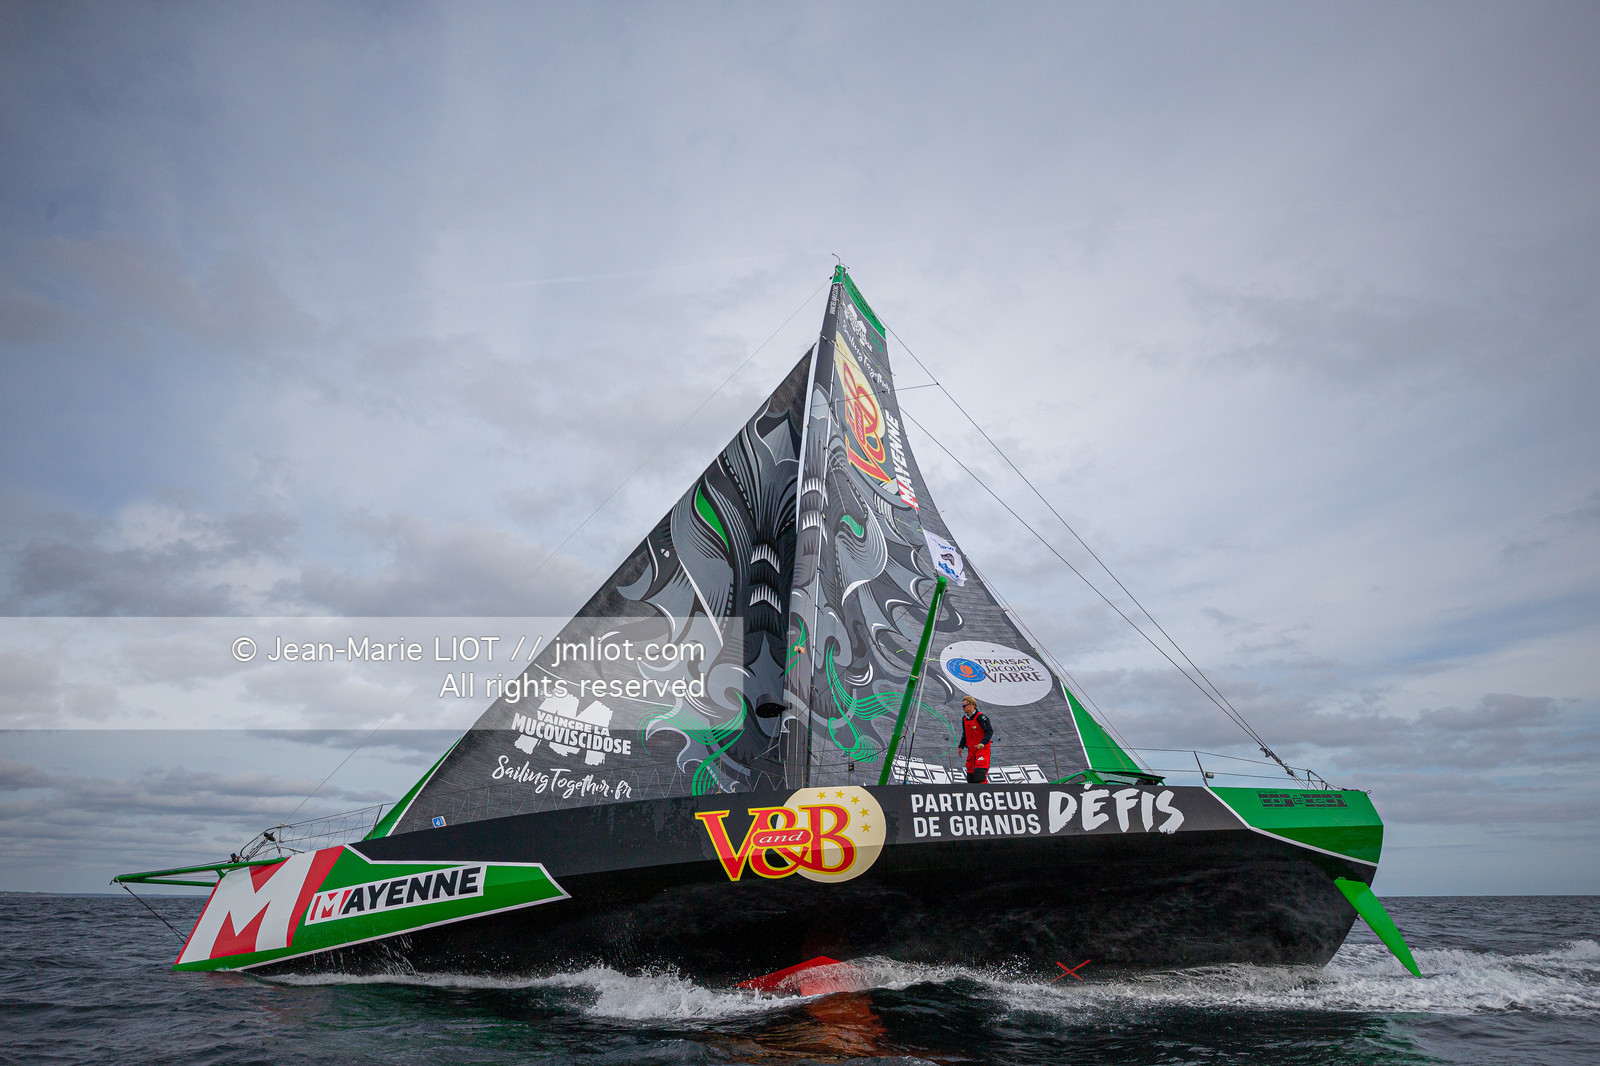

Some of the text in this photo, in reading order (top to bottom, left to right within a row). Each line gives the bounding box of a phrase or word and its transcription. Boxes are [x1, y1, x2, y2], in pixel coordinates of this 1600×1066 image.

[885, 409, 919, 511] MAYENNE
[975, 658, 1030, 666] TRANSAT
[983, 671, 1046, 683] VABRE
[511, 712, 632, 756] MUCOVISCIDOSE
[536, 710, 611, 737] VAINCRE LA
[911, 791, 1038, 813] PARTAGEUR
[1048, 783, 1185, 834] DÉFIS
[759, 832, 801, 844] and
[913, 814, 1042, 838] DE GRANDS
[311, 866, 482, 921] MAYENNE
